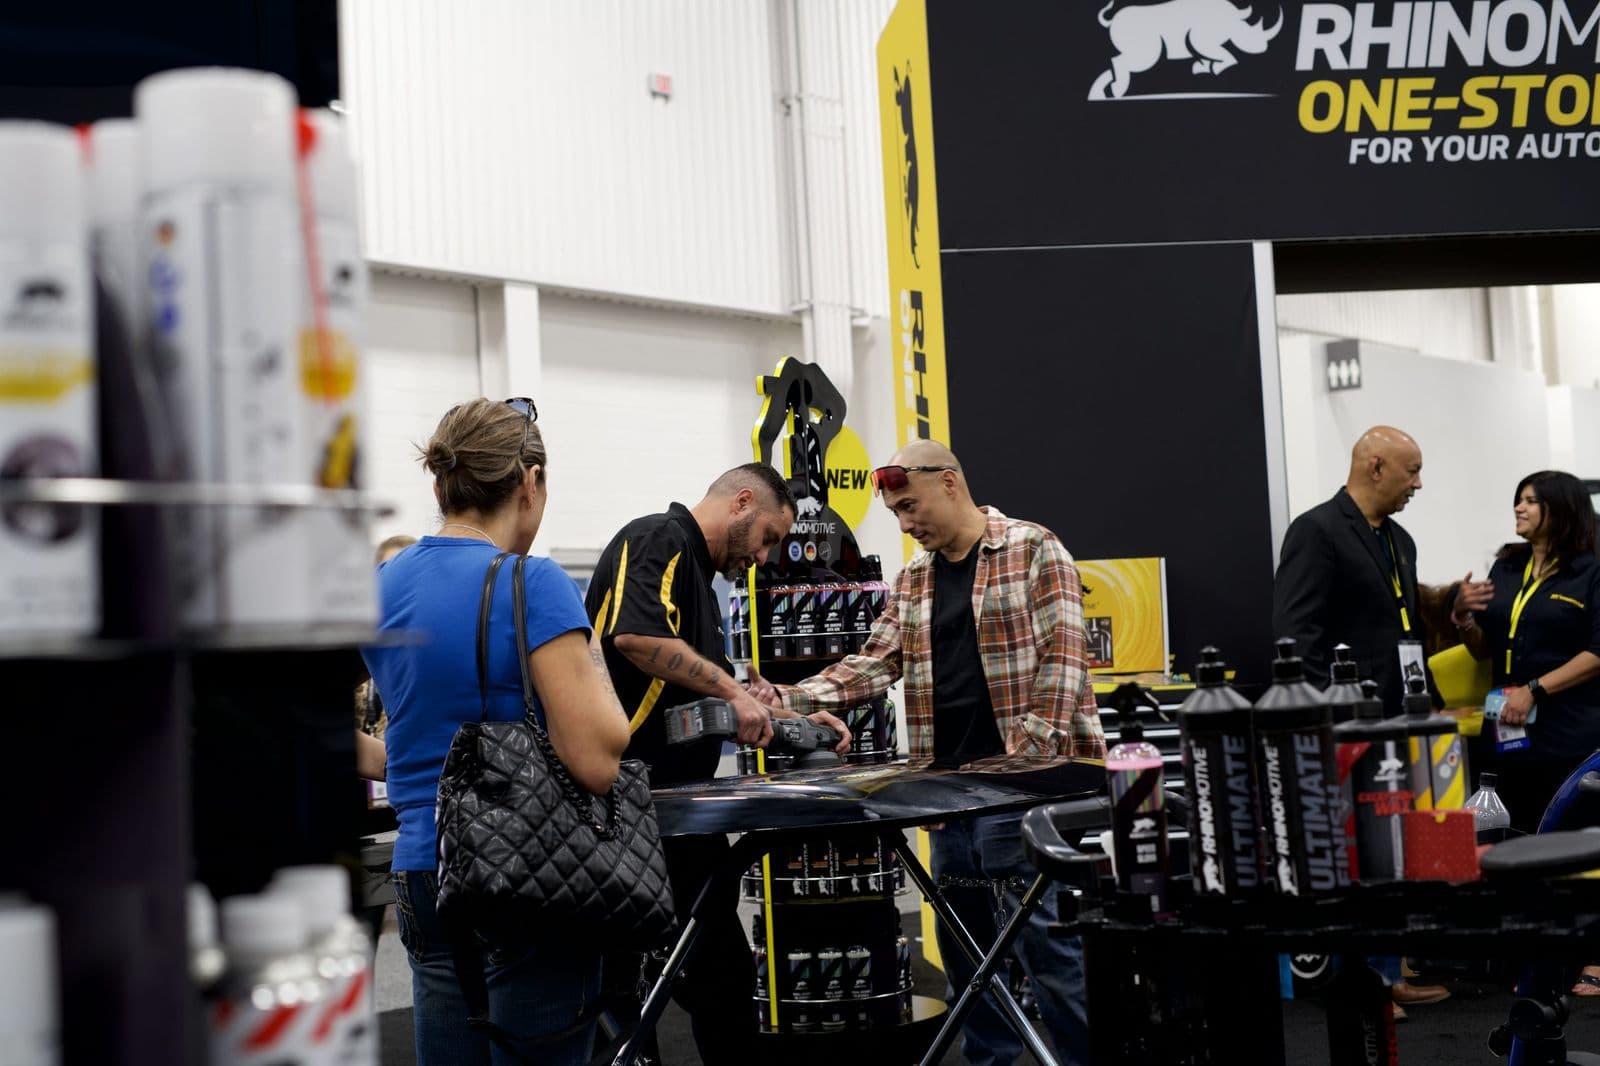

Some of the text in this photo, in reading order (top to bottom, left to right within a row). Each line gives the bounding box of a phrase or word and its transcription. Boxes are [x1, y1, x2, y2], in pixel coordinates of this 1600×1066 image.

[1349, 131, 1600, 164] FOR YOUR AUTO
[827, 468, 868, 490] NEW
[1192, 747, 1217, 855] RHINOMOTIVE
[1222, 734, 1258, 887] ULTIMATE
[1264, 746, 1290, 856] RHINOMOTIVE
[1293, 733, 1335, 890] ULTIMATE
